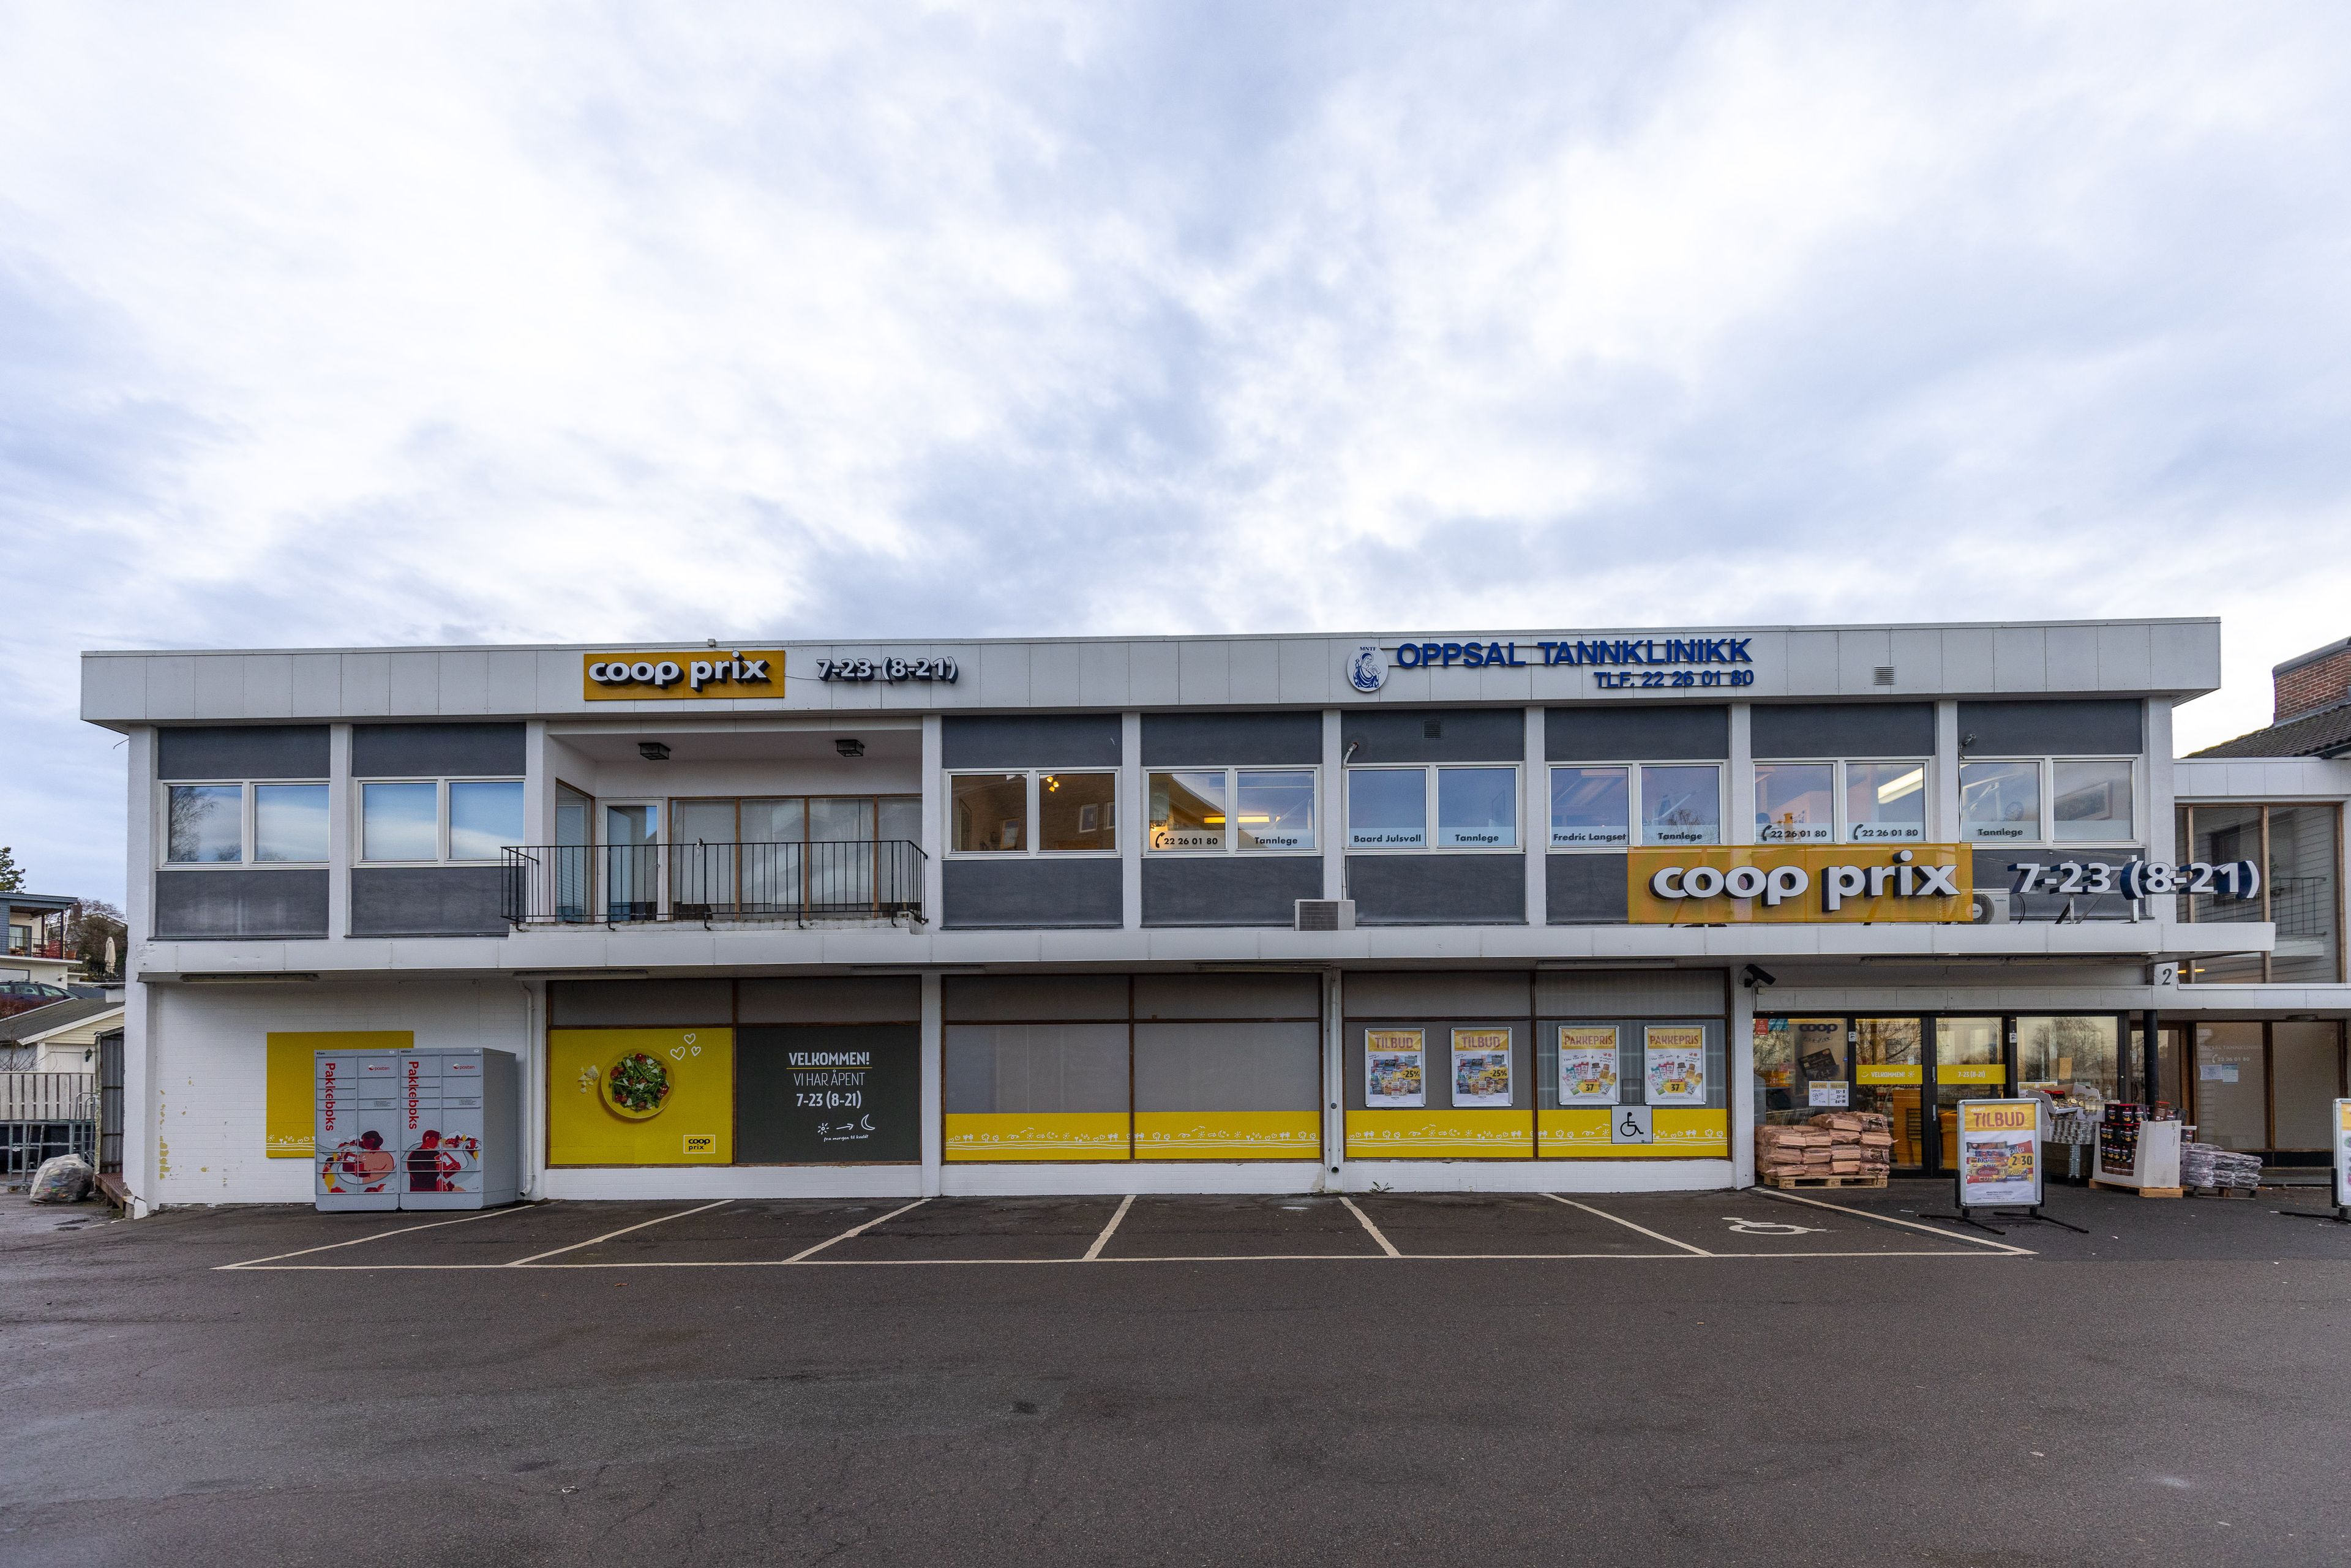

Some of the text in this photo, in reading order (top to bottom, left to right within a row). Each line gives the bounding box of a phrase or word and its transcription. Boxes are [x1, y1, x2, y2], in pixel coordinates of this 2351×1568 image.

[1397, 637, 1753, 667] OPPSAL TANNKLINIKK
[588, 650, 771, 691] coop prix
[816, 656, 959, 684] 7-23 (8-21)
[1594, 669, 1755, 688] TLF. 22 26 01 80
[1385, 834, 1422, 842] Julsvoll
[1455, 834, 1499, 843] Tannlege
[1588, 833, 1627, 842] Langset
[1658, 832, 1703, 841] Tannlege
[1978, 828, 2023, 838] Tannlege
[1254, 836, 1298, 846] Tannlege
[1650, 850, 1962, 912] coop prix
[2011, 860, 2260, 899] 7-23 (8-21)
[2162, 968, 2172, 985] 2
[1799, 1023, 1838, 1034] coop
[1376, 1037, 1413, 1049] TILBUD
[1461, 1036, 1500, 1048] TILBUD
[1564, 1035, 1613, 1046] PAKKEPRIS
[1650, 1034, 1699, 1045] PAKKEPRIS
[789, 1052, 869, 1065] VELKOMMEN!
[793, 1069, 865, 1086] VI HAR ÅPENT
[1970, 1070, 1986, 1079] (8-21)
[325, 1063, 336, 1131] Pakkeboks
[408, 1062, 419, 1130] Pakkeboks
[797, 1090, 861, 1109] 7-23 (8-21)
[1973, 1112, 2025, 1127] TILBUD
[2012, 1156, 2017, 1166] 2
[2021, 1155, 2033, 1166] 30
